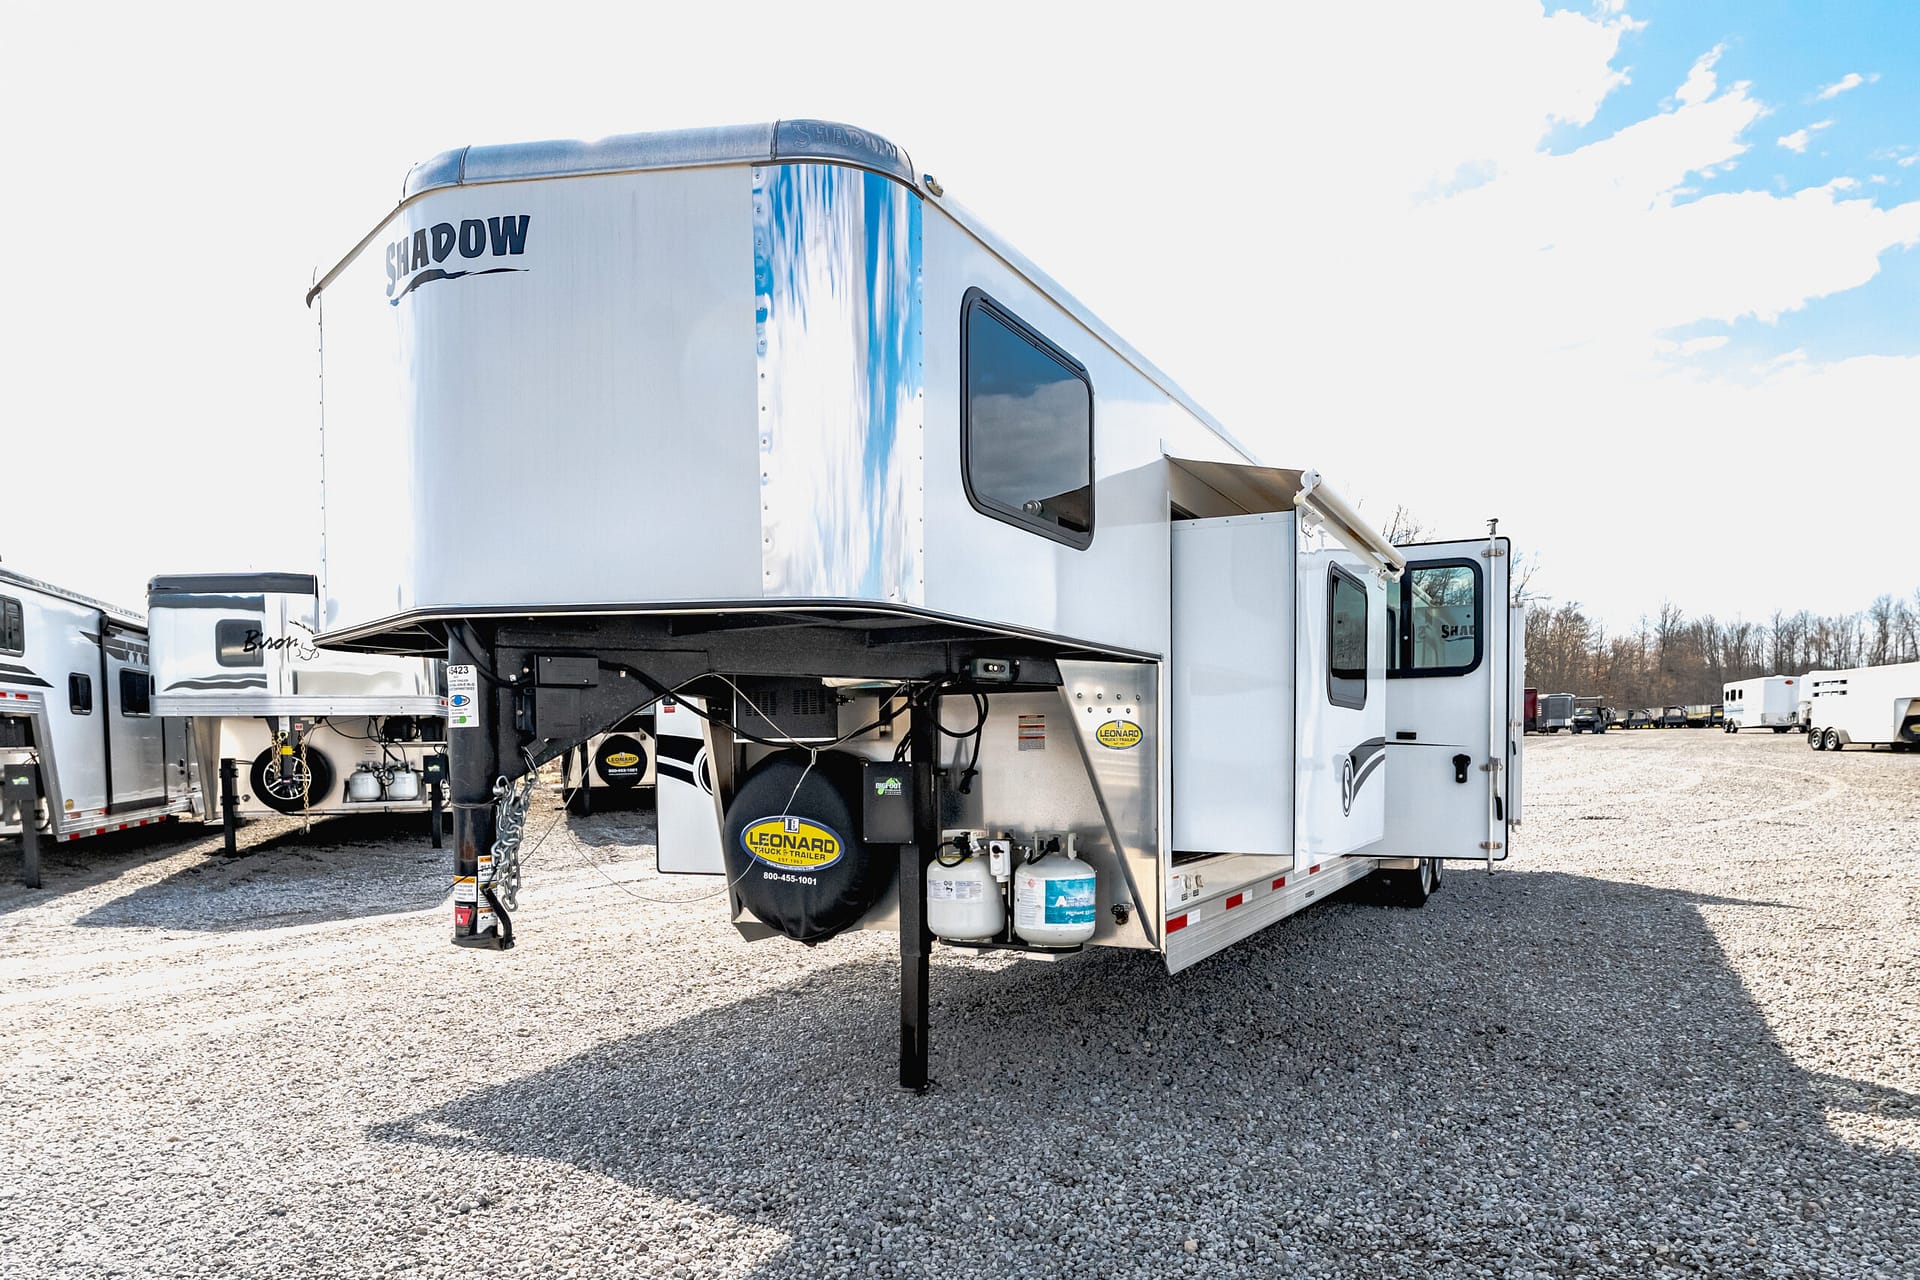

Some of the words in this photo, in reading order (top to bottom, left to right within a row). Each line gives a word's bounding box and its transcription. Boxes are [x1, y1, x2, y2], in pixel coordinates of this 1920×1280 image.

[385, 214, 531, 298] SHADOW
[243, 629, 299, 653] Bison
[1099, 729, 1139, 738] LEONARD
[749, 831, 835, 854] LEONARD
[753, 846, 781, 856] TRUCK
[790, 850, 826, 861] TRAILER
[763, 871, 817, 886] 800-455-1001
